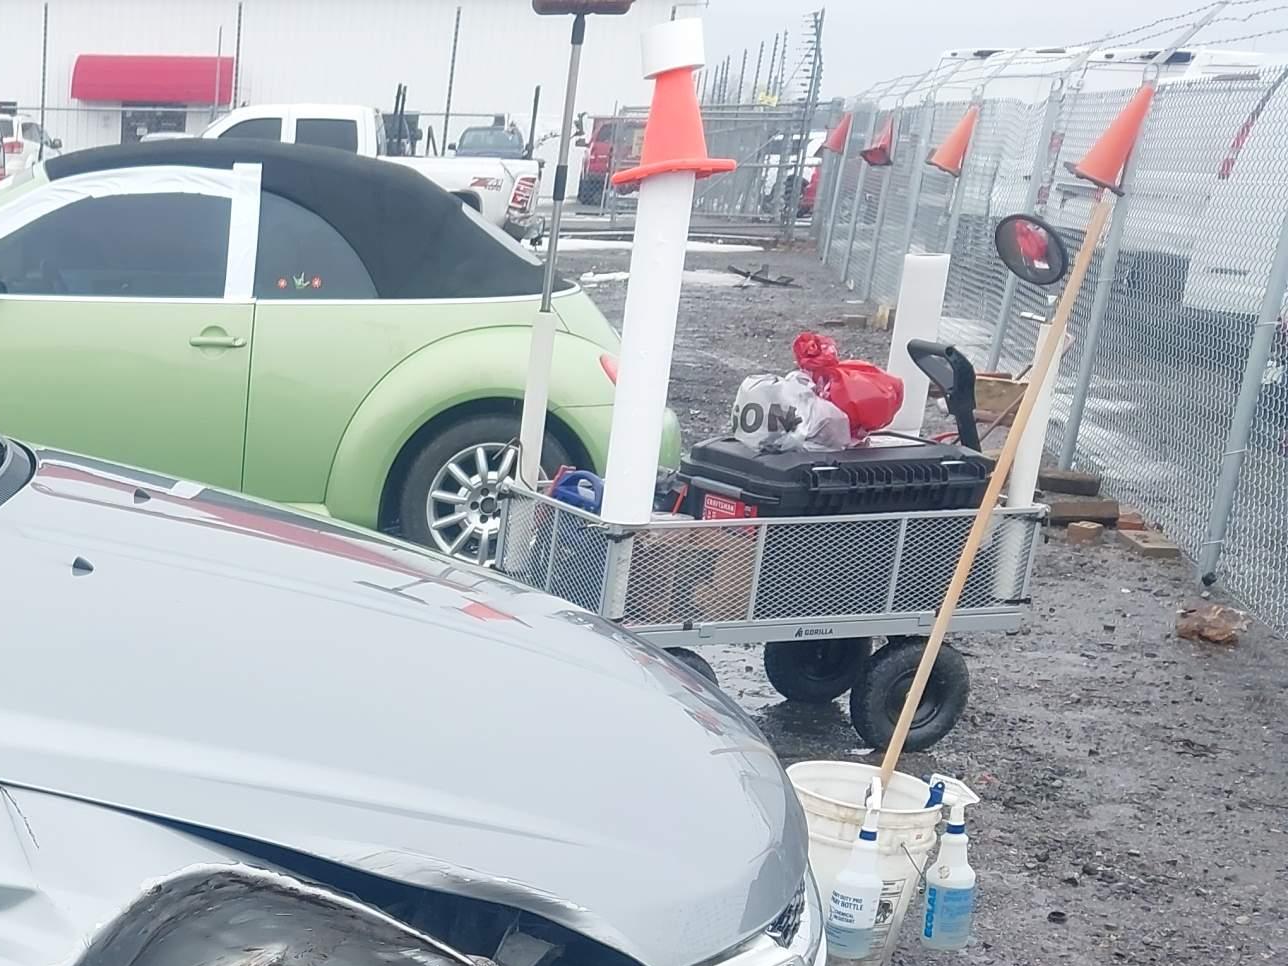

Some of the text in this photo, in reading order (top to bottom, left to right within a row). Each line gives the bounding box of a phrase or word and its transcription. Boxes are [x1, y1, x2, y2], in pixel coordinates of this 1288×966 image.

[706, 498, 734, 512] CRAFTSMAN
[804, 628, 834, 636] GORILLA
[840, 900, 864, 911] BOTTLE
